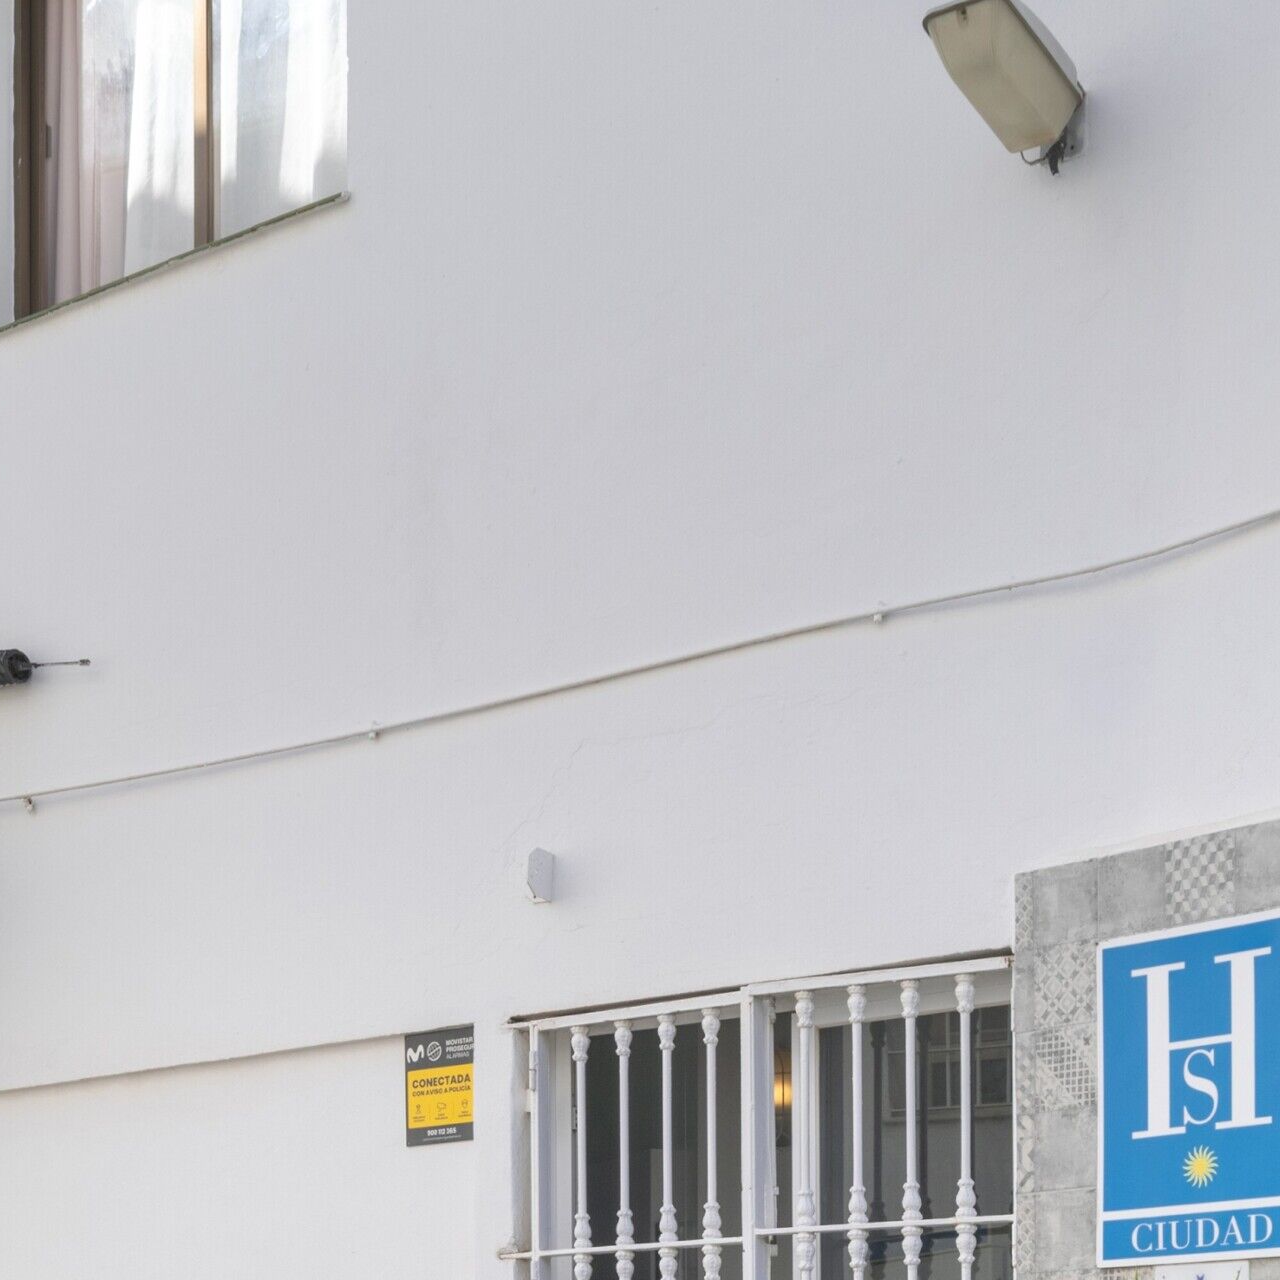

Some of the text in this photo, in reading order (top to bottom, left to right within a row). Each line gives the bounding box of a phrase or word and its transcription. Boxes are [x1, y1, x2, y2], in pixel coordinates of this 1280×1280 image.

[446, 1037, 473, 1046] MOVISTAR
[412, 1073, 471, 1089] CONECTADA
[1130, 1213, 1273, 1253] CIUDAD
